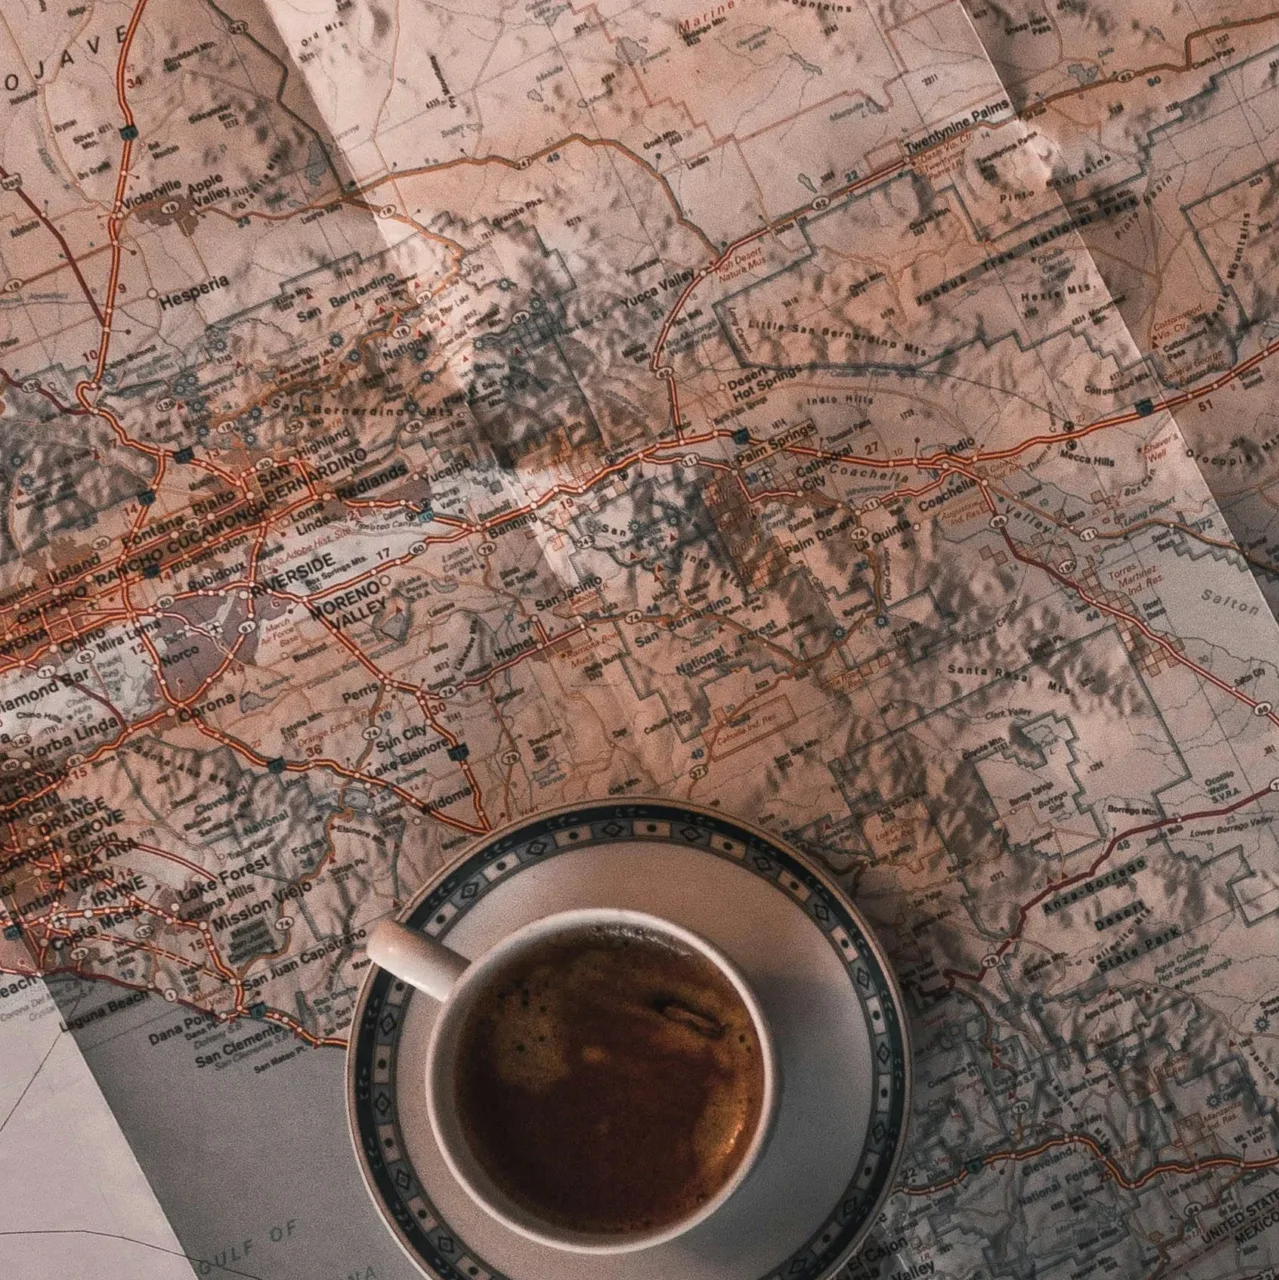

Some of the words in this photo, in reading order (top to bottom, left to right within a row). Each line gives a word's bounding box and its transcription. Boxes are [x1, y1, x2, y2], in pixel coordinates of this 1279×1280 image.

[678, 2, 735, 33] Marine
[904, 112, 972, 155] Twentynine
[971, 98, 1010, 122] Palms
[123, 180, 182, 210] Victorville
[1000, 190, 1035, 204] Pinto
[1046, 154, 1111, 188] Mountains
[735, 247, 763, 265] Desert
[982, 251, 1014, 271] Tree
[1029, 216, 1092, 249] National
[1226, 211, 1251, 280] Mountains
[159, 274, 229, 311] Hesperia
[622, 279, 660, 309] Yucca
[662, 267, 694, 291] Valley
[383, 332, 433, 360] National
[727, 366, 768, 391] Desert
[732, 385, 755, 402] Hot
[757, 365, 802, 392] Springs
[737, 444, 767, 466] Palm
[768, 422, 815, 452] Springs
[946, 437, 976, 454] Indio
[1060, 448, 1088, 464] Mecca
[1089, 452, 1115, 468] Hills
[257, 466, 291, 486] SAN
[264, 448, 367, 503] BERNARDINO
[335, 463, 408, 500] Redlands
[918, 479, 977, 512] Coachella
[171, 534, 248, 574] Bloomington
[250, 552, 336, 599] RIVERSIDE
[309, 580, 380, 621] MORENO
[330, 595, 388, 632] VALLEY
[1201, 589, 1260, 617] Salton
[635, 632, 660, 648] San
[668, 595, 731, 632] Bernardino
[739, 619, 777, 645] Forest
[494, 637, 536, 662] Hemet
[676, 645, 725, 675] National
[947, 664, 987, 677] Santa
[995, 668, 1029, 682] Rosa
[178, 693, 236, 722] Corona
[25, 732, 73, 760] Yorba
[74, 717, 119, 741] Linda
[1190, 827, 1215, 838] Lower
[1216, 822, 1249, 836] Borrego
[1250, 814, 1274, 831] Valley
[91, 876, 147, 906] IRVINE
[1043, 858, 1147, 914] Anza-Borrego
[212, 900, 273, 932] Mission
[273, 881, 313, 907] Viejo
[1095, 901, 1146, 932] Desert
[1098, 948, 1140, 972] State
[1145, 926, 1181, 948] Park
[59, 1004, 106, 1034] Laguna
[107, 988, 150, 1017] Beach
[195, 1052, 222, 1069] San
[223, 1025, 283, 1055] Clemente
[198, 1238, 255, 1276] GULF
[269, 1218, 299, 1244] OF
[1201, 1214, 1246, 1245] UNITED
